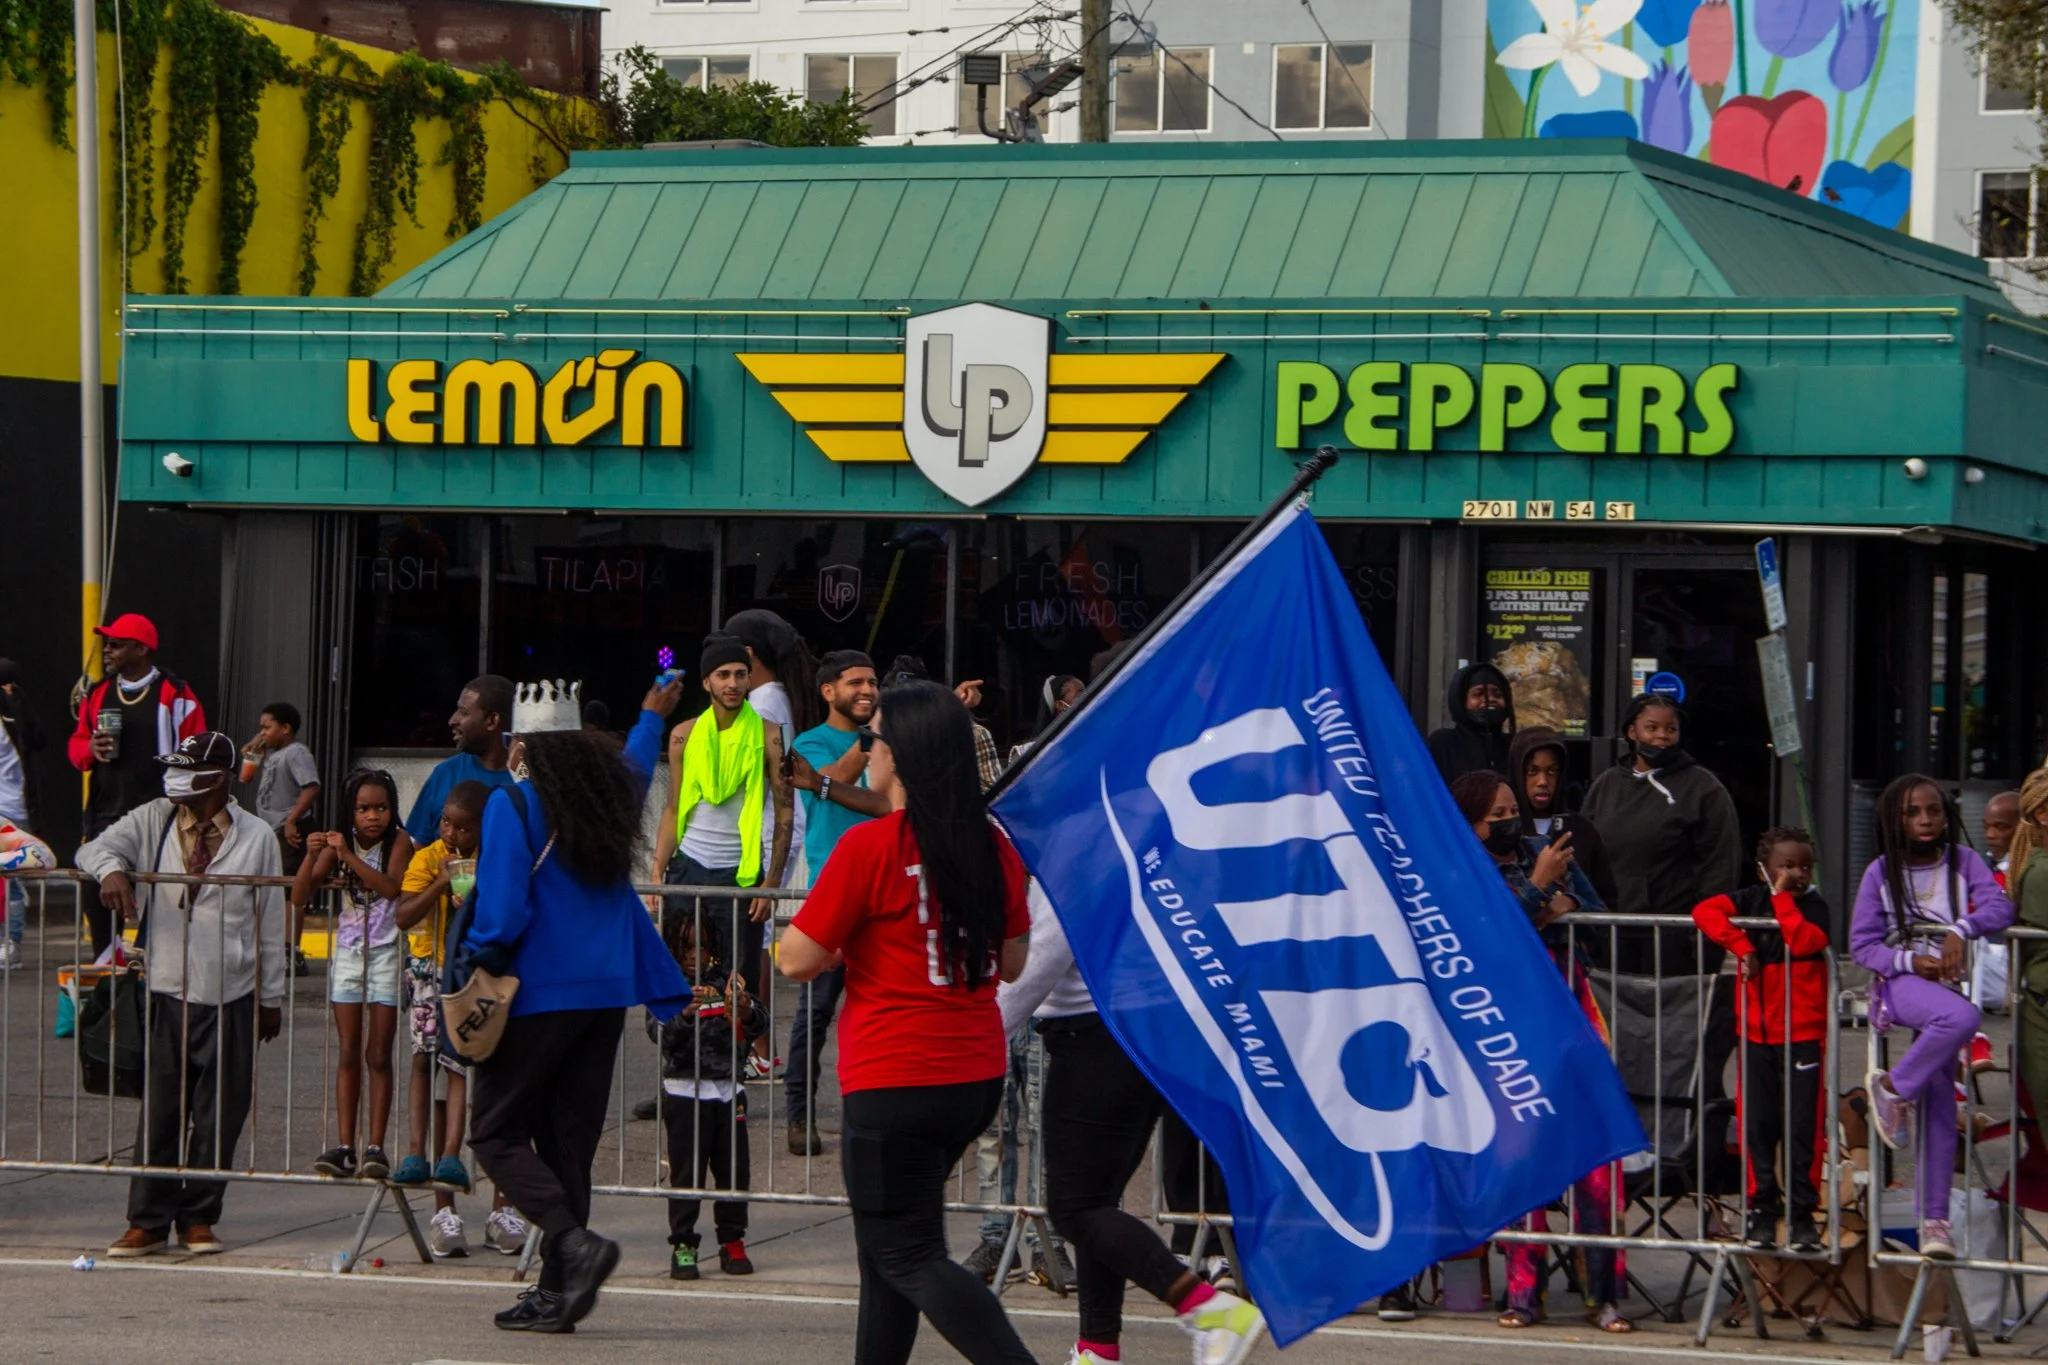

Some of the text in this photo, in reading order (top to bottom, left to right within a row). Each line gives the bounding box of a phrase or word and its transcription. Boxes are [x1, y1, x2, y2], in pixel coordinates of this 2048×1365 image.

[347, 348, 688, 447] LEMON
[921, 333, 1034, 468] LP
[1275, 360, 1738, 457] PEPPERS
[1465, 502, 1632, 518] 2701 NW 54 ST
[1015, 561, 1139, 595] FRESH
[1486, 570, 1590, 586] GRILLED FISH
[1489, 601, 1586, 612] CATFISH FILLET
[1495, 591, 1519, 601] PCS
[1571, 591, 1591, 601] OR
[1004, 599, 1149, 631] LEMONADES
[1302, 687, 1380, 798] UNITED
[1146, 706, 1496, 1155] UTD
[1142, 846, 1286, 1089] WE EDUCATE MIAMI
[1449, 986, 1505, 1026] OF
[1474, 1031, 1557, 1123] DADE
